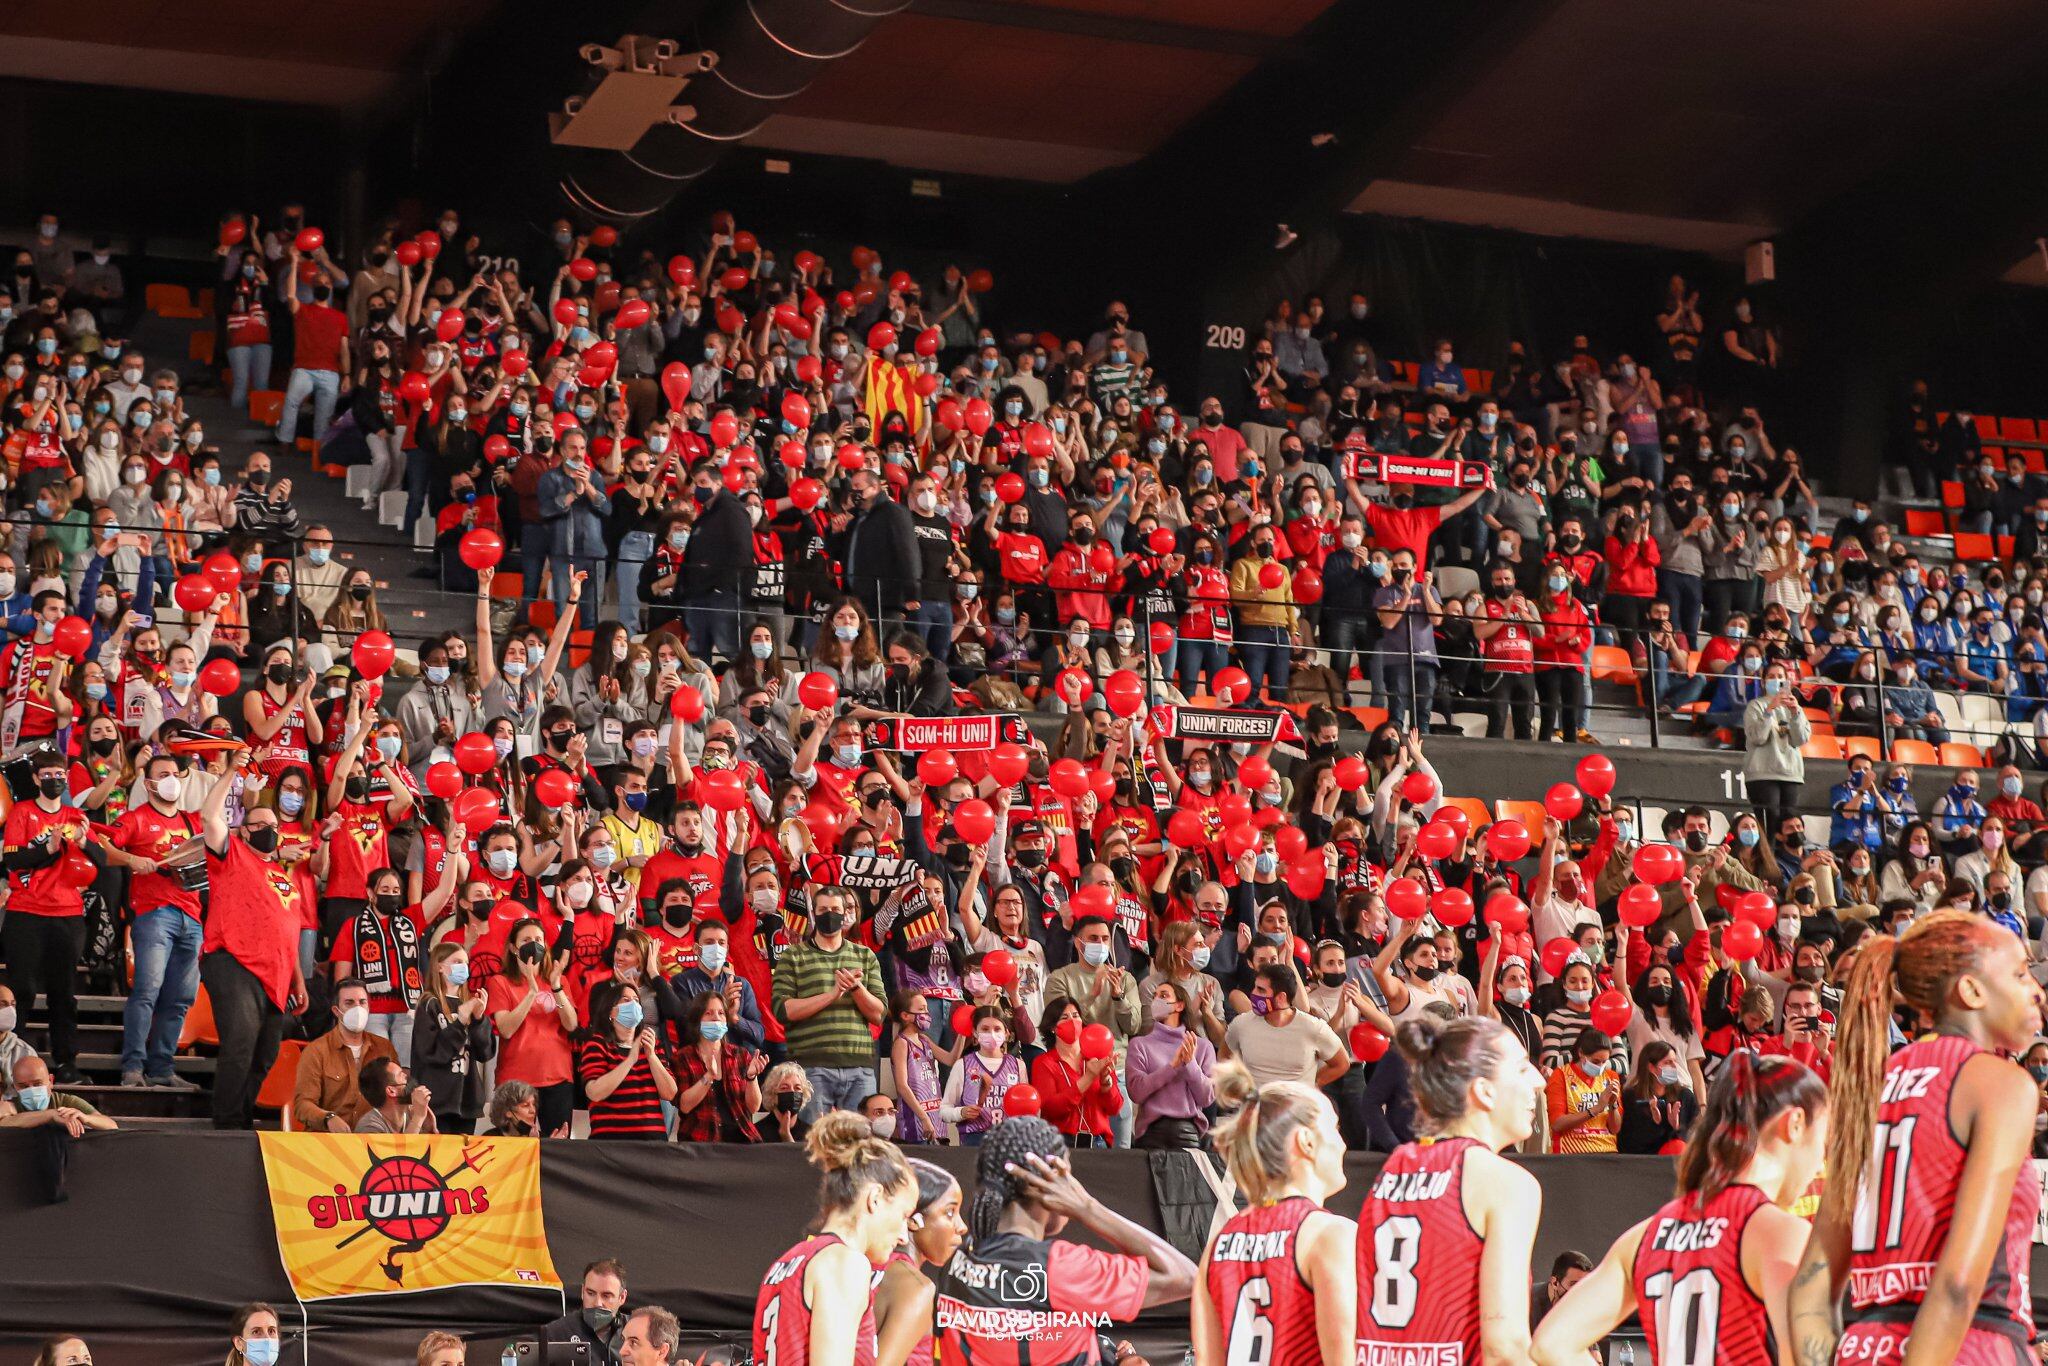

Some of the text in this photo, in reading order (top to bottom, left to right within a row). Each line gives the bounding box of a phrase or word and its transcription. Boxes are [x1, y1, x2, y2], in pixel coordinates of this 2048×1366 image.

[1206, 324, 1246, 350] 209
[39, 433, 50, 448] 3
[1507, 626, 1517, 639] 8
[906, 722, 989, 745] SOM-HI UNI!
[1181, 714, 1272, 735] UNIM FORCES!
[279, 728, 292, 746] 3
[271, 748, 300, 759] PAR
[1720, 769, 1748, 802] 11
[845, 856, 916, 876] UNI
[843, 874, 912, 889] GIRONA
[904, 891, 925, 911] UNI
[363, 962, 383, 974] UNI
[677, 954, 699, 963] UNI
[936, 965, 949, 986] 8
[931, 1081, 938, 1096] 8
[987, 1086, 1007, 1096] PAR
[1581, 1092, 1602, 1103] SPA
[1372, 1166, 1452, 1203] RAÚJO
[1853, 1116, 1918, 1251] 11
[1369, 1216, 1421, 1328] 8
[1226, 1277, 1274, 1366] 6
[1645, 1267, 1721, 1366] 10
[1356, 1346, 1459, 1366] AUHAUS
